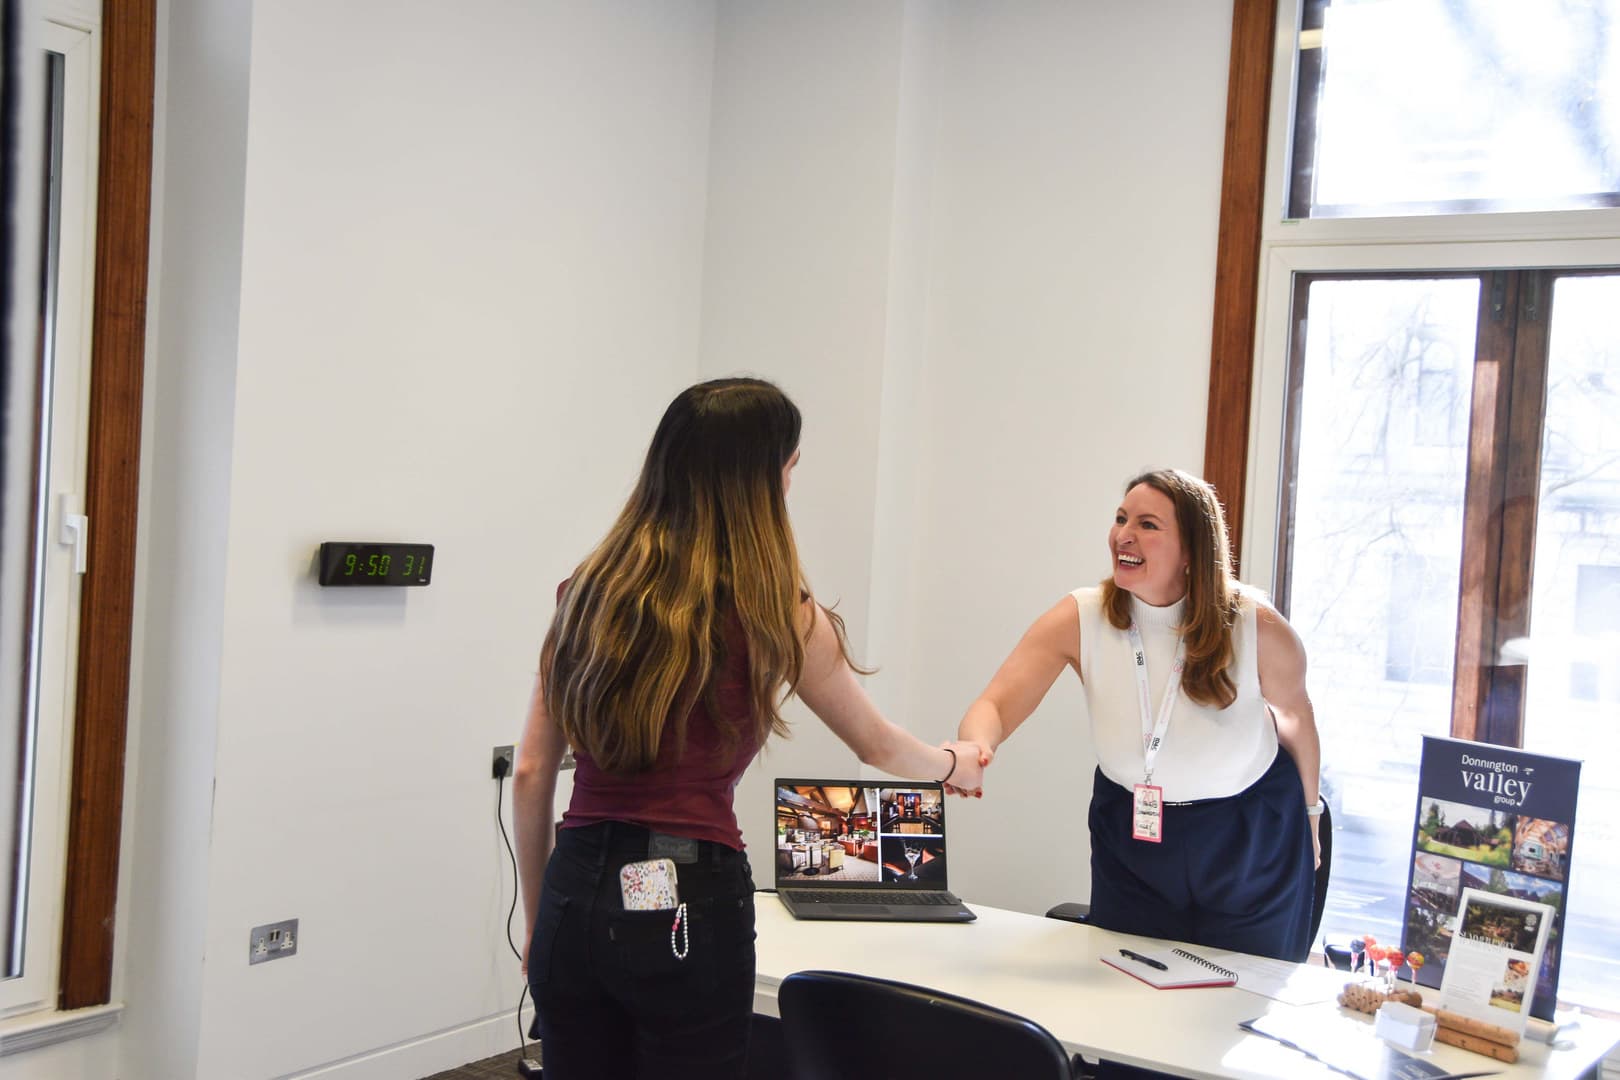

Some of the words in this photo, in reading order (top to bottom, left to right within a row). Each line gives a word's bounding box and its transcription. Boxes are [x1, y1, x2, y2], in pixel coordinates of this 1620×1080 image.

[344, 554, 391, 575] 9:50
[402, 555, 425, 576] 31
[1461, 754, 1518, 774] Donnington
[1461, 770, 1533, 807] valley
[1494, 795, 1516, 806] group
